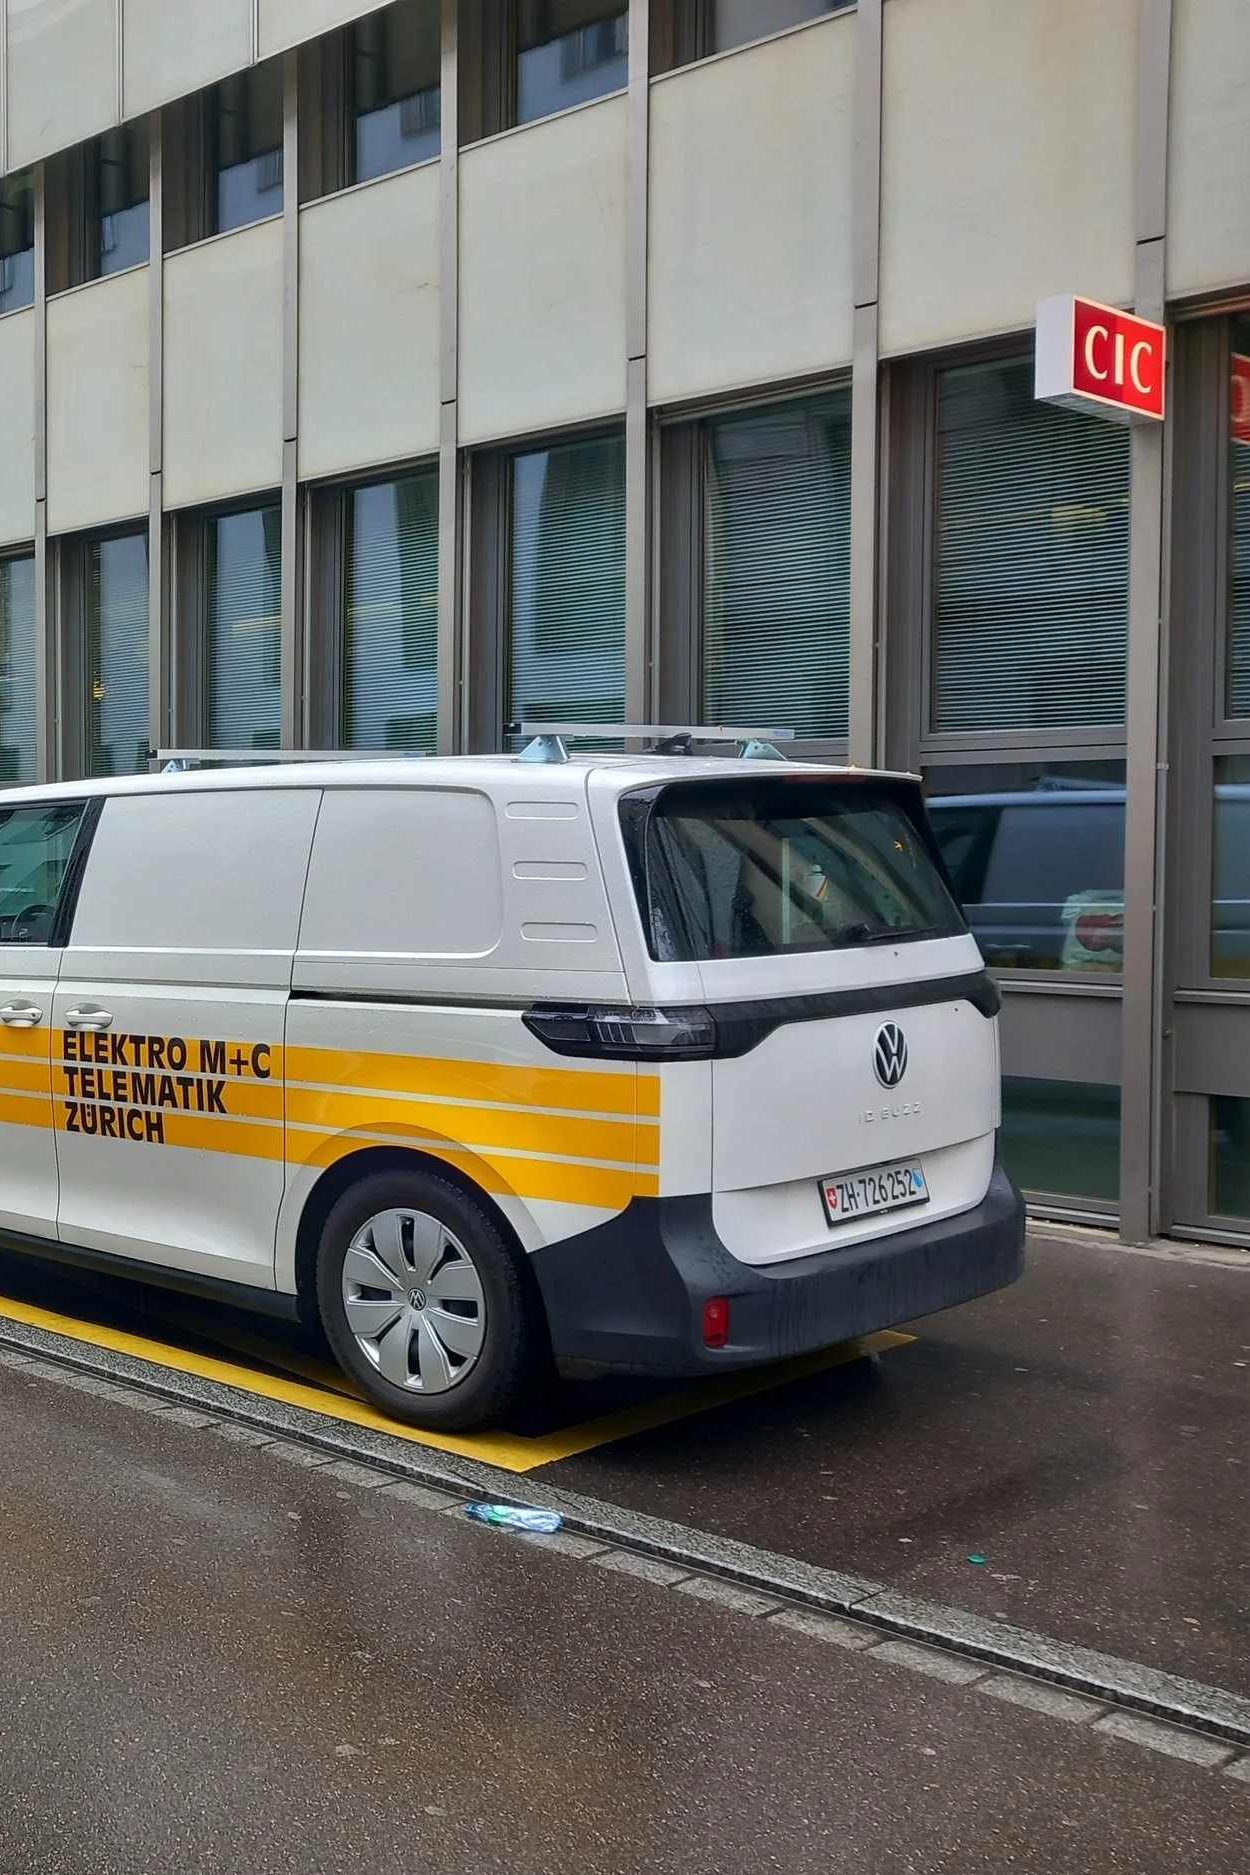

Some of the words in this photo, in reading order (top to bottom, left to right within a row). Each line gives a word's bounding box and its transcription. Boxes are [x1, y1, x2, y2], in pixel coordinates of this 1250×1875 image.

[1085, 325, 1152, 394] CIC
[63, 1030, 187, 1071] ELEKTRO
[200, 1039, 271, 1079] M+C
[63, 1066, 228, 1114] TELEMATIK
[881, 1101, 922, 1120] BUZZ
[65, 1101, 165, 1144] ZÜRICH
